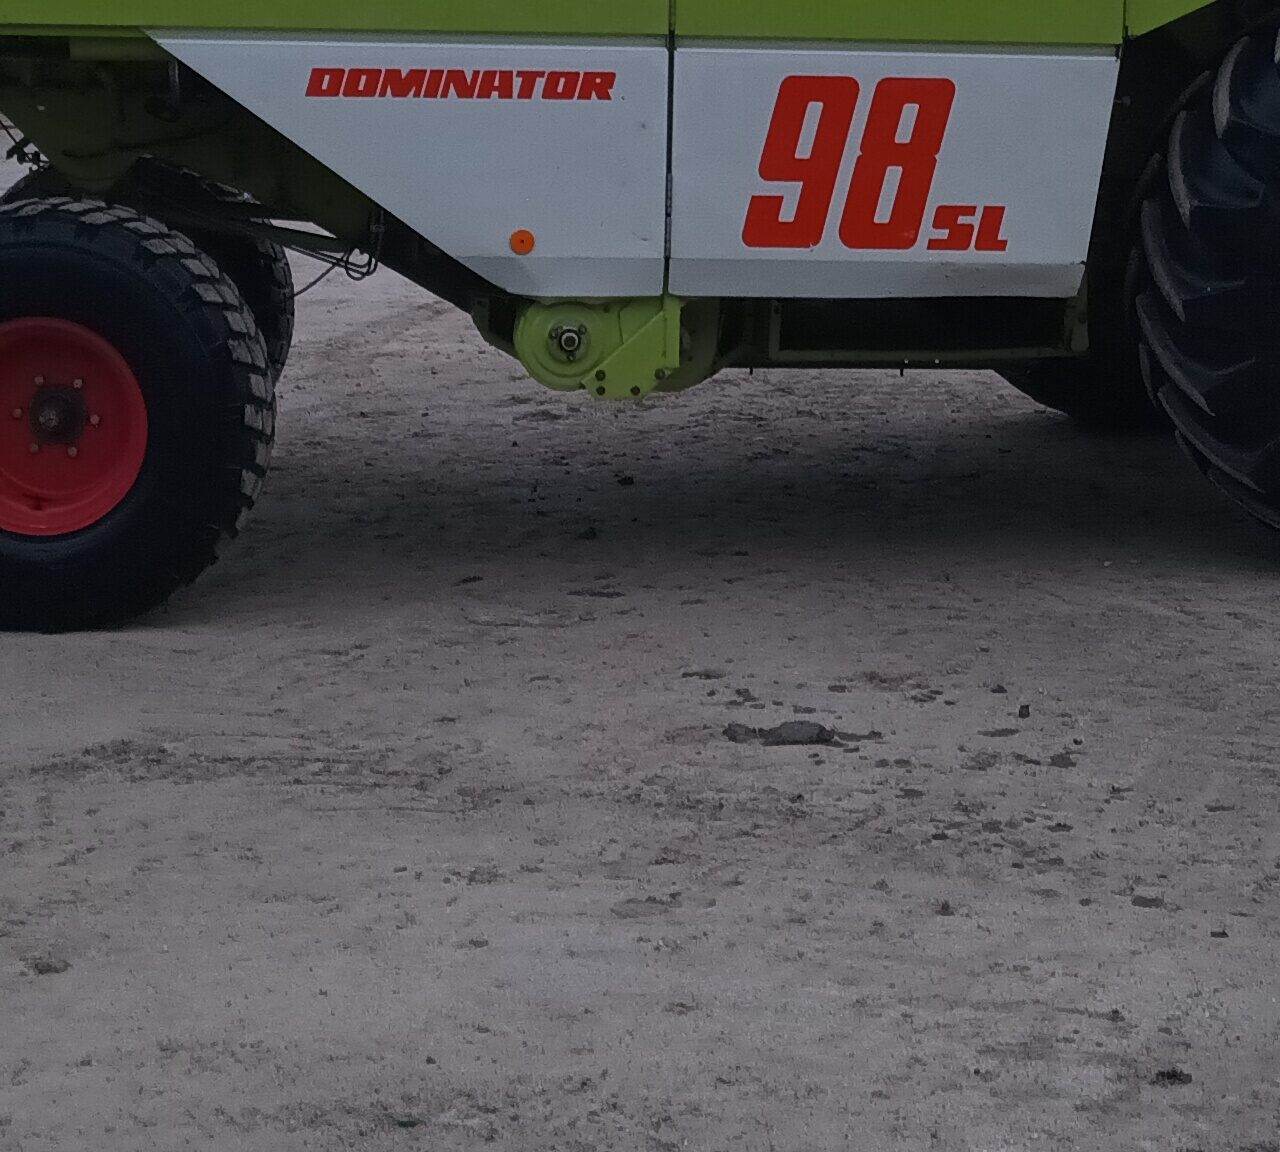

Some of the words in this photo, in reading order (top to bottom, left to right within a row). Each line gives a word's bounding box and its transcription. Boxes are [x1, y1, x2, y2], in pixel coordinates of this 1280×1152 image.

[306, 67, 617, 101] DOMINATOR
[741, 74, 957, 251] 98
[926, 204, 1009, 252] SL
